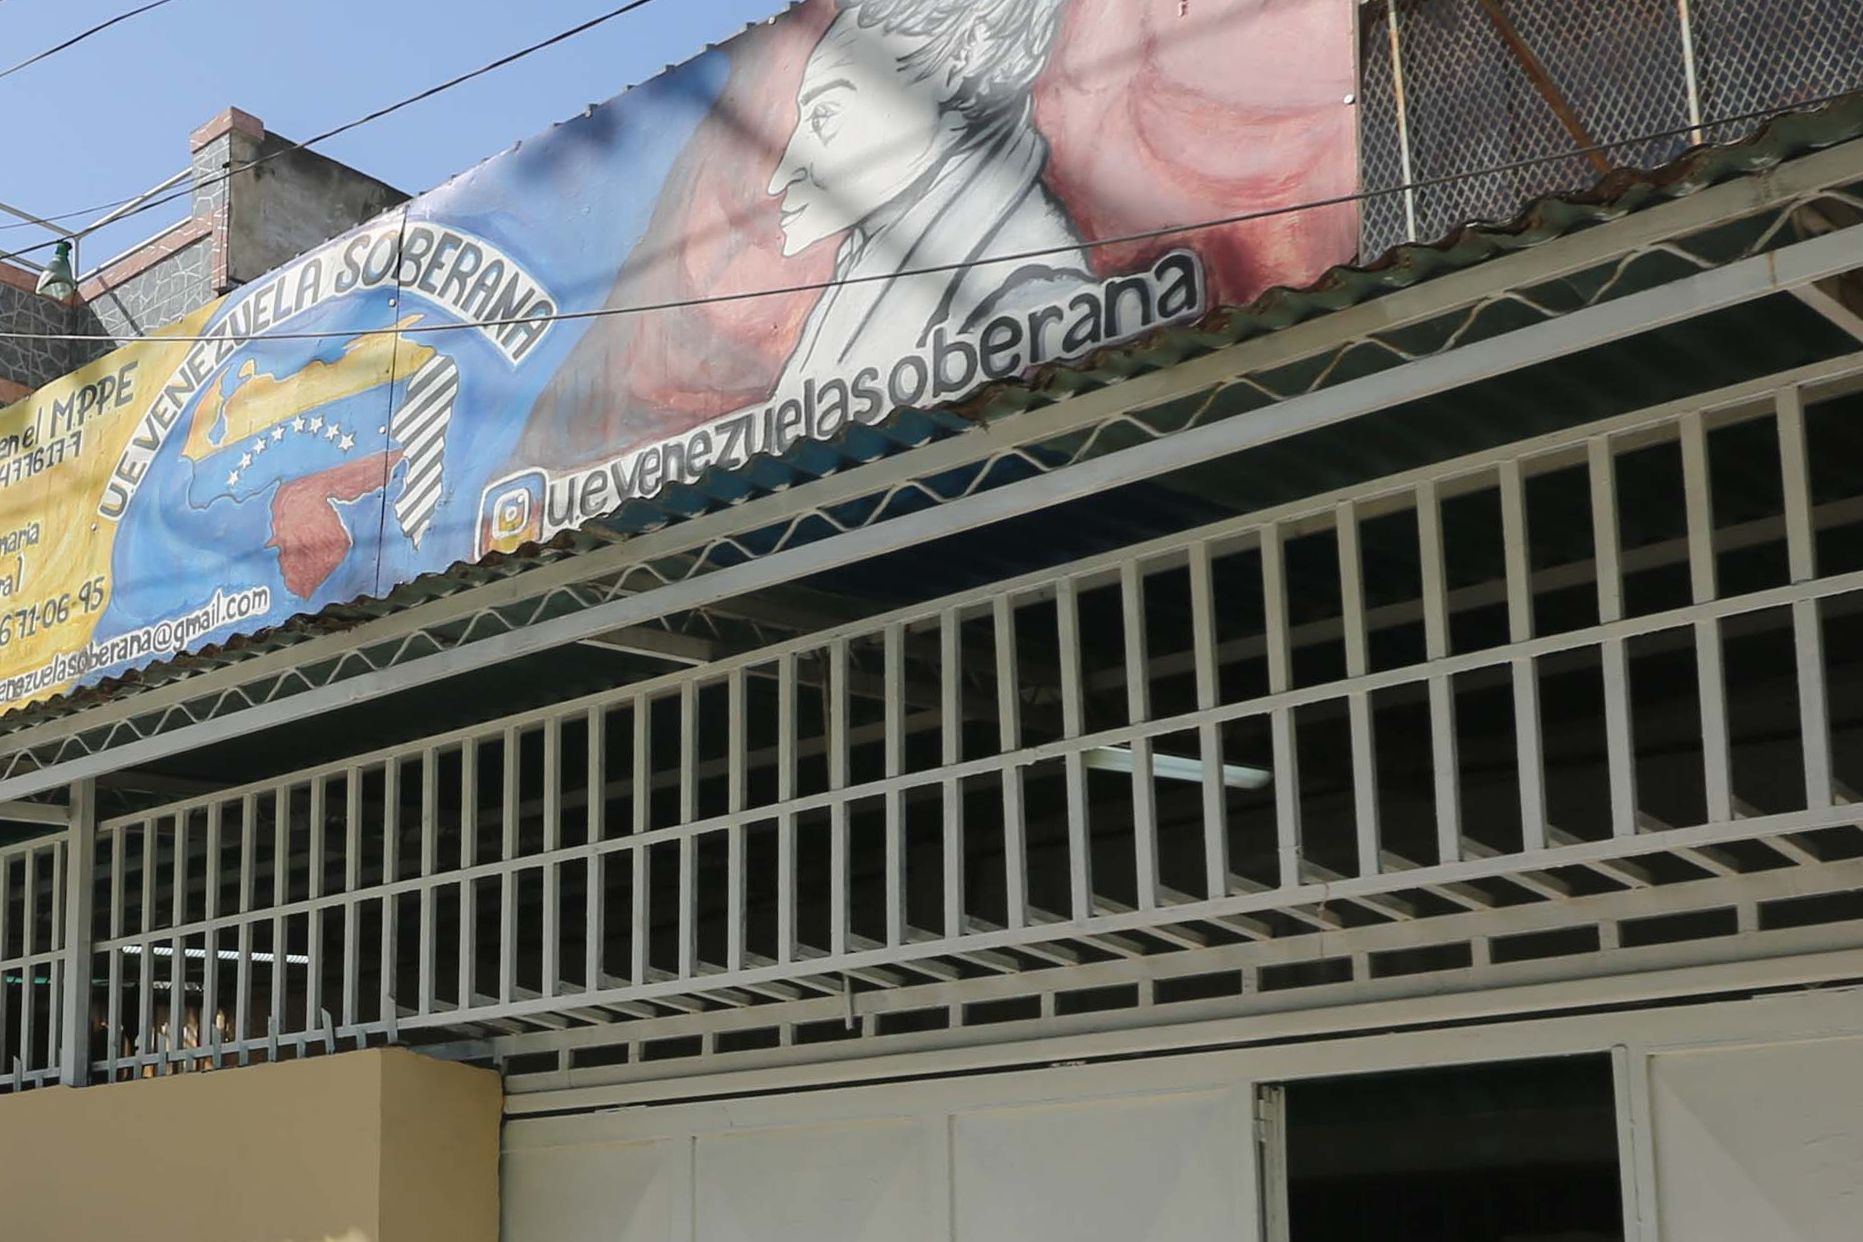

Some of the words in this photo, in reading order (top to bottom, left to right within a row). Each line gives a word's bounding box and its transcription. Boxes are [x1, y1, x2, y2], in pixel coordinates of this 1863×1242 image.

[132, 257, 322, 451] VENEZUELA
[336, 227, 556, 364] SOBERANA
[20, 406, 43, 448] el
